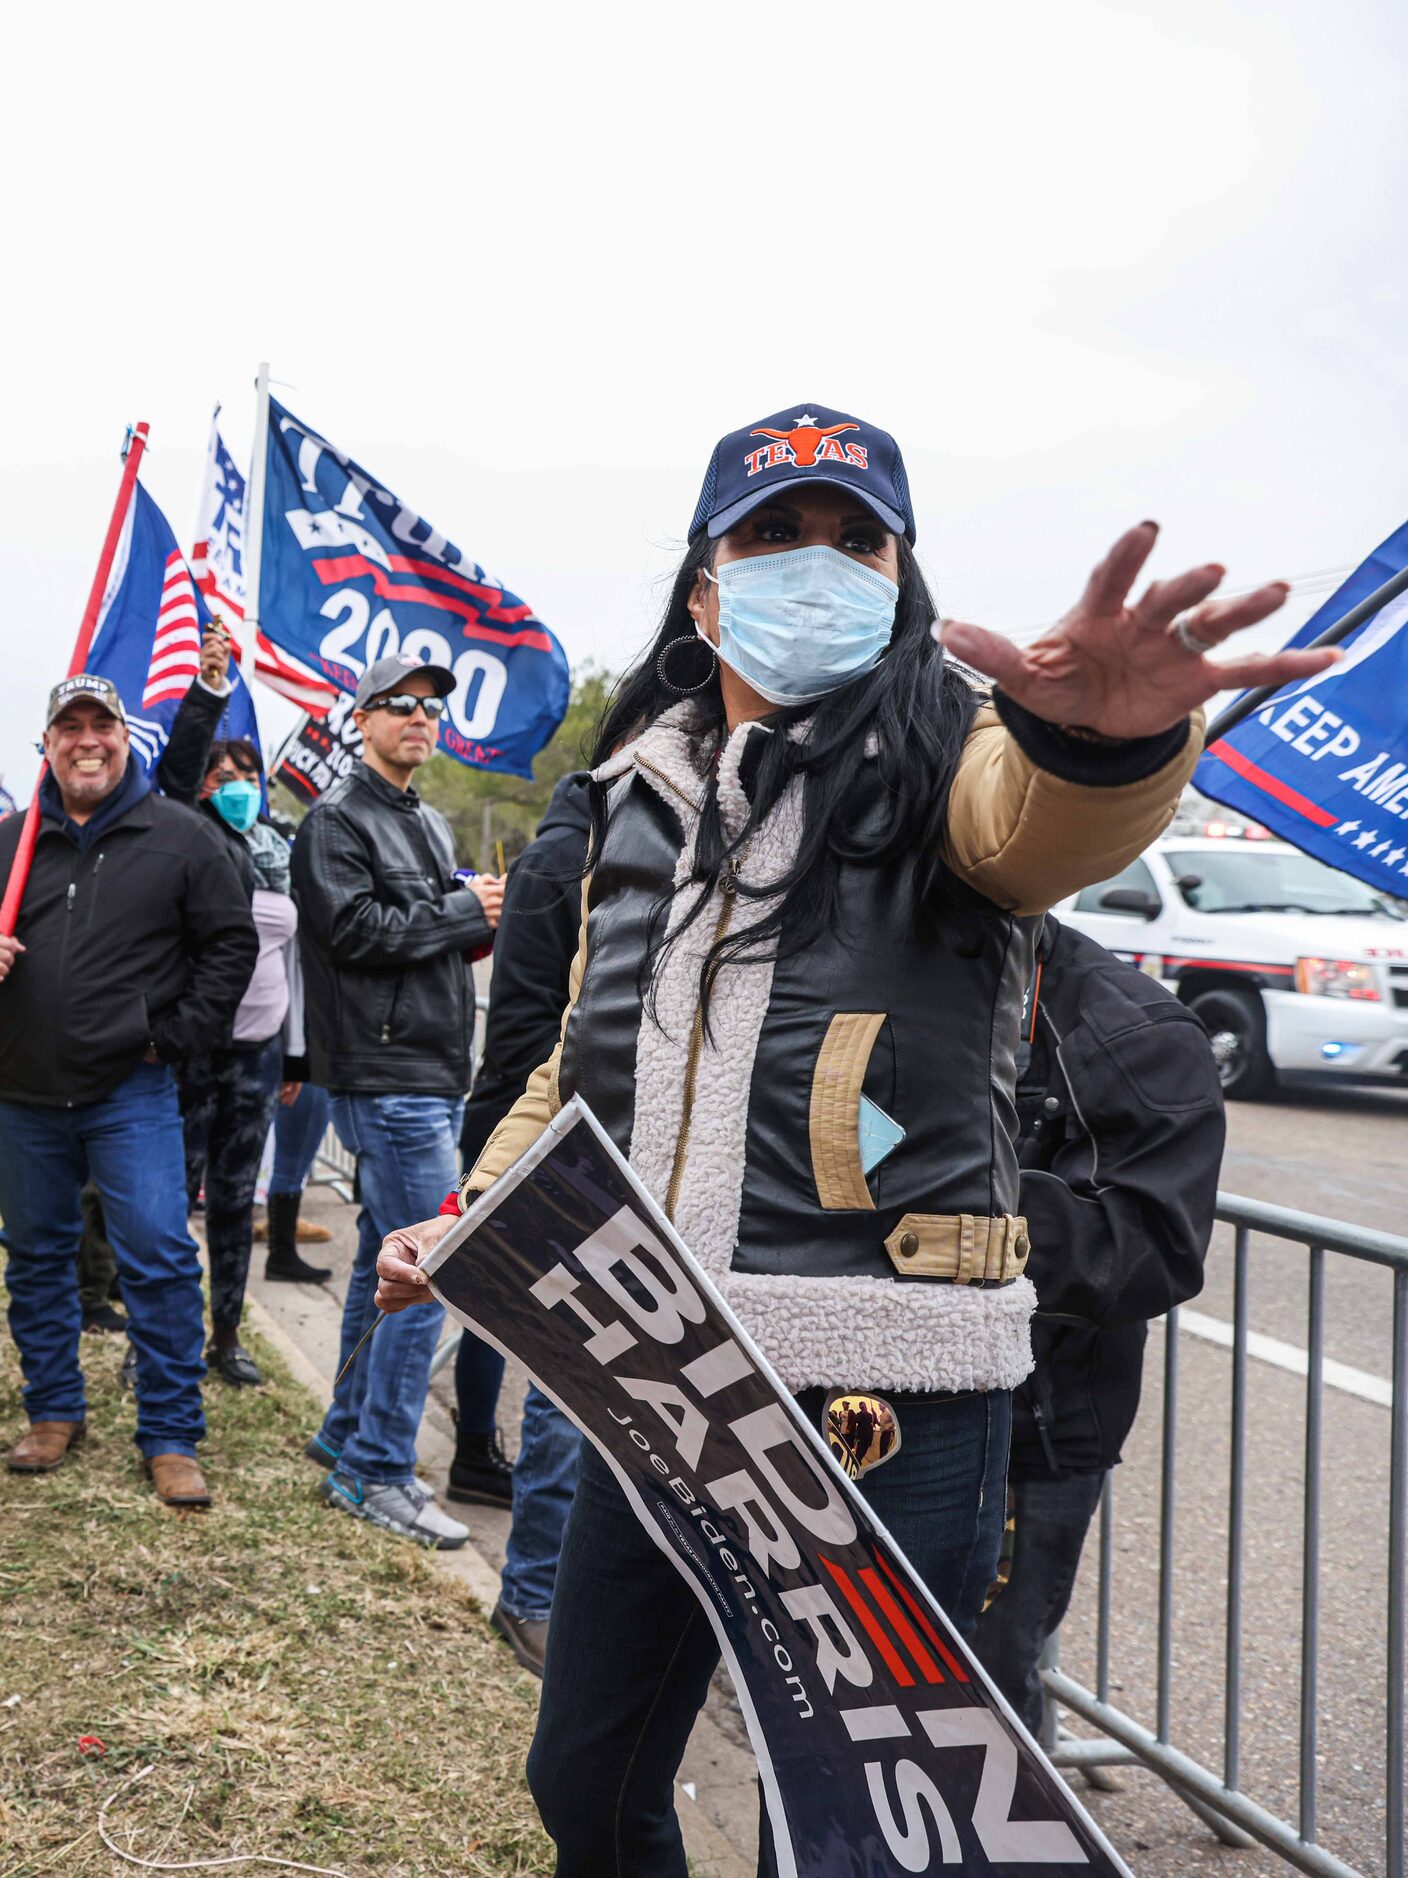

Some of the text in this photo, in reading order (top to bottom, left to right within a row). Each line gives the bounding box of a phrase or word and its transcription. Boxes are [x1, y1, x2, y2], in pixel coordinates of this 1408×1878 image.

[744, 438, 869, 477] TEAS
[528, 1262, 963, 1873] HARRIS
[573, 1204, 1090, 1864] BIDEN
